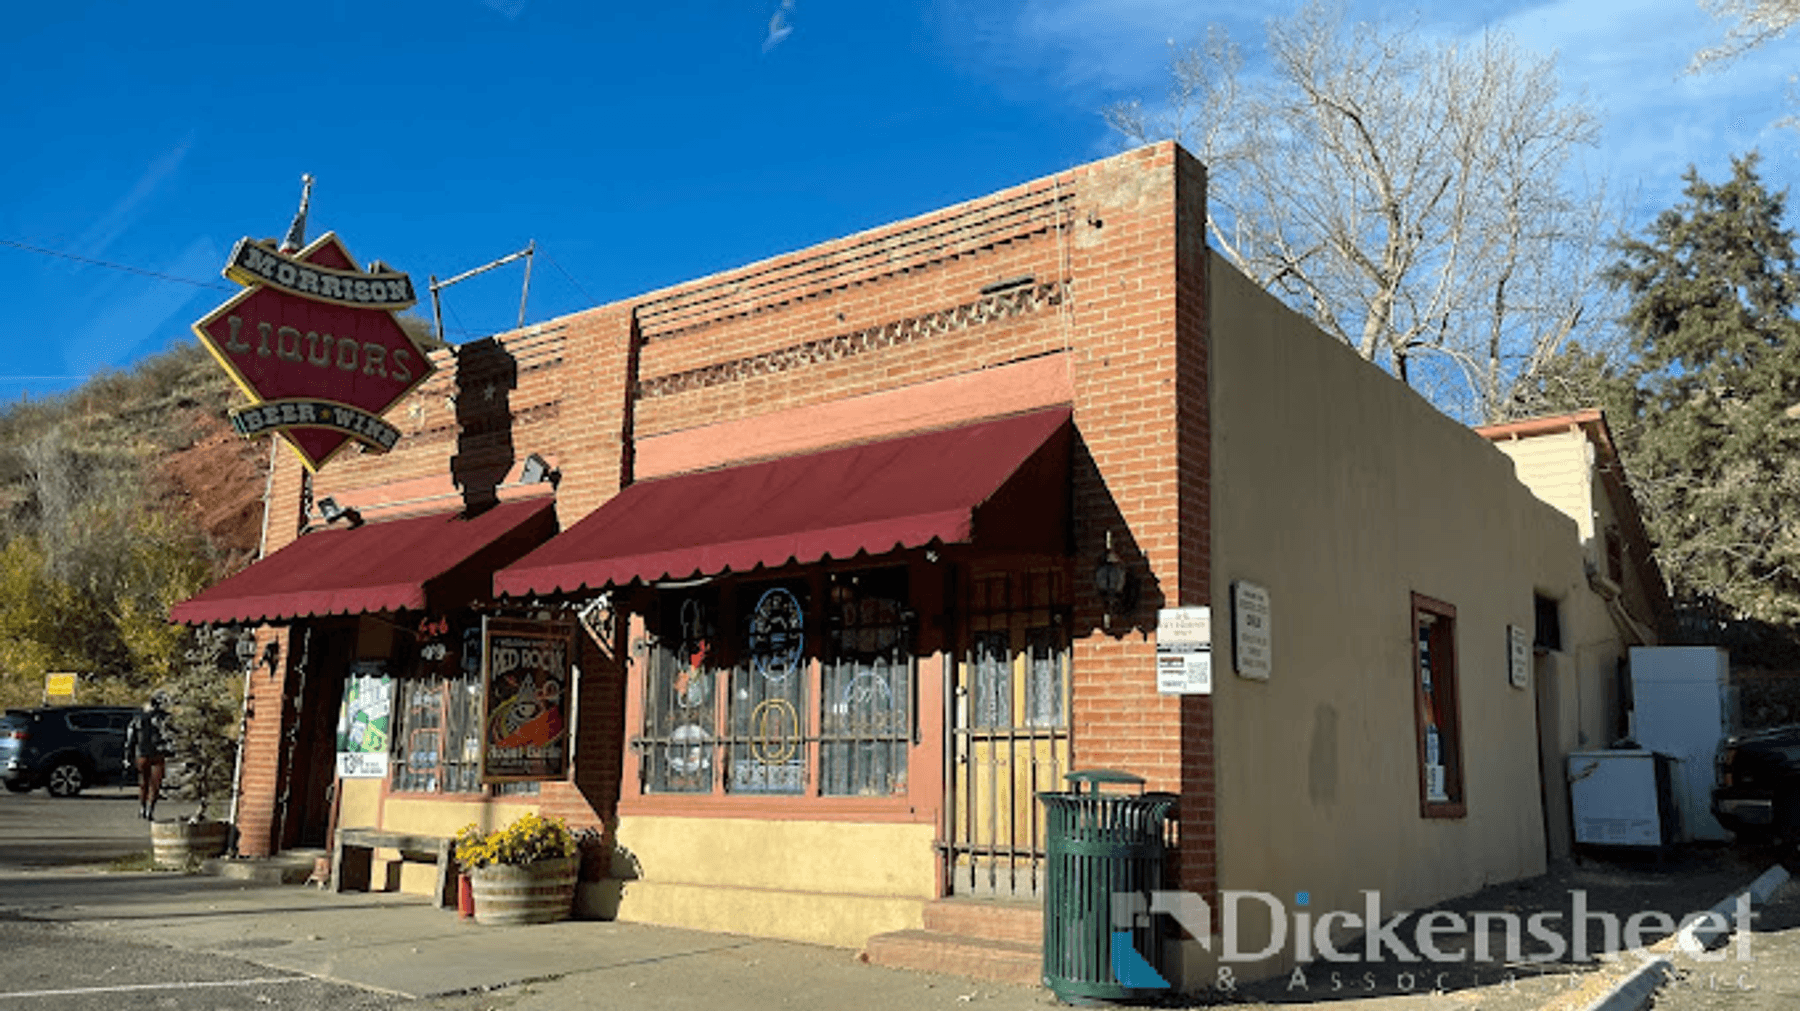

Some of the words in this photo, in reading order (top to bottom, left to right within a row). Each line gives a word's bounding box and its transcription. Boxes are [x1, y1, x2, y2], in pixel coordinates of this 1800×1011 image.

[244, 248, 409, 300] MORRISON
[226, 317, 411, 382] LIQUORS
[244, 405, 316, 430] BEER
[333, 408, 397, 446] WINE
